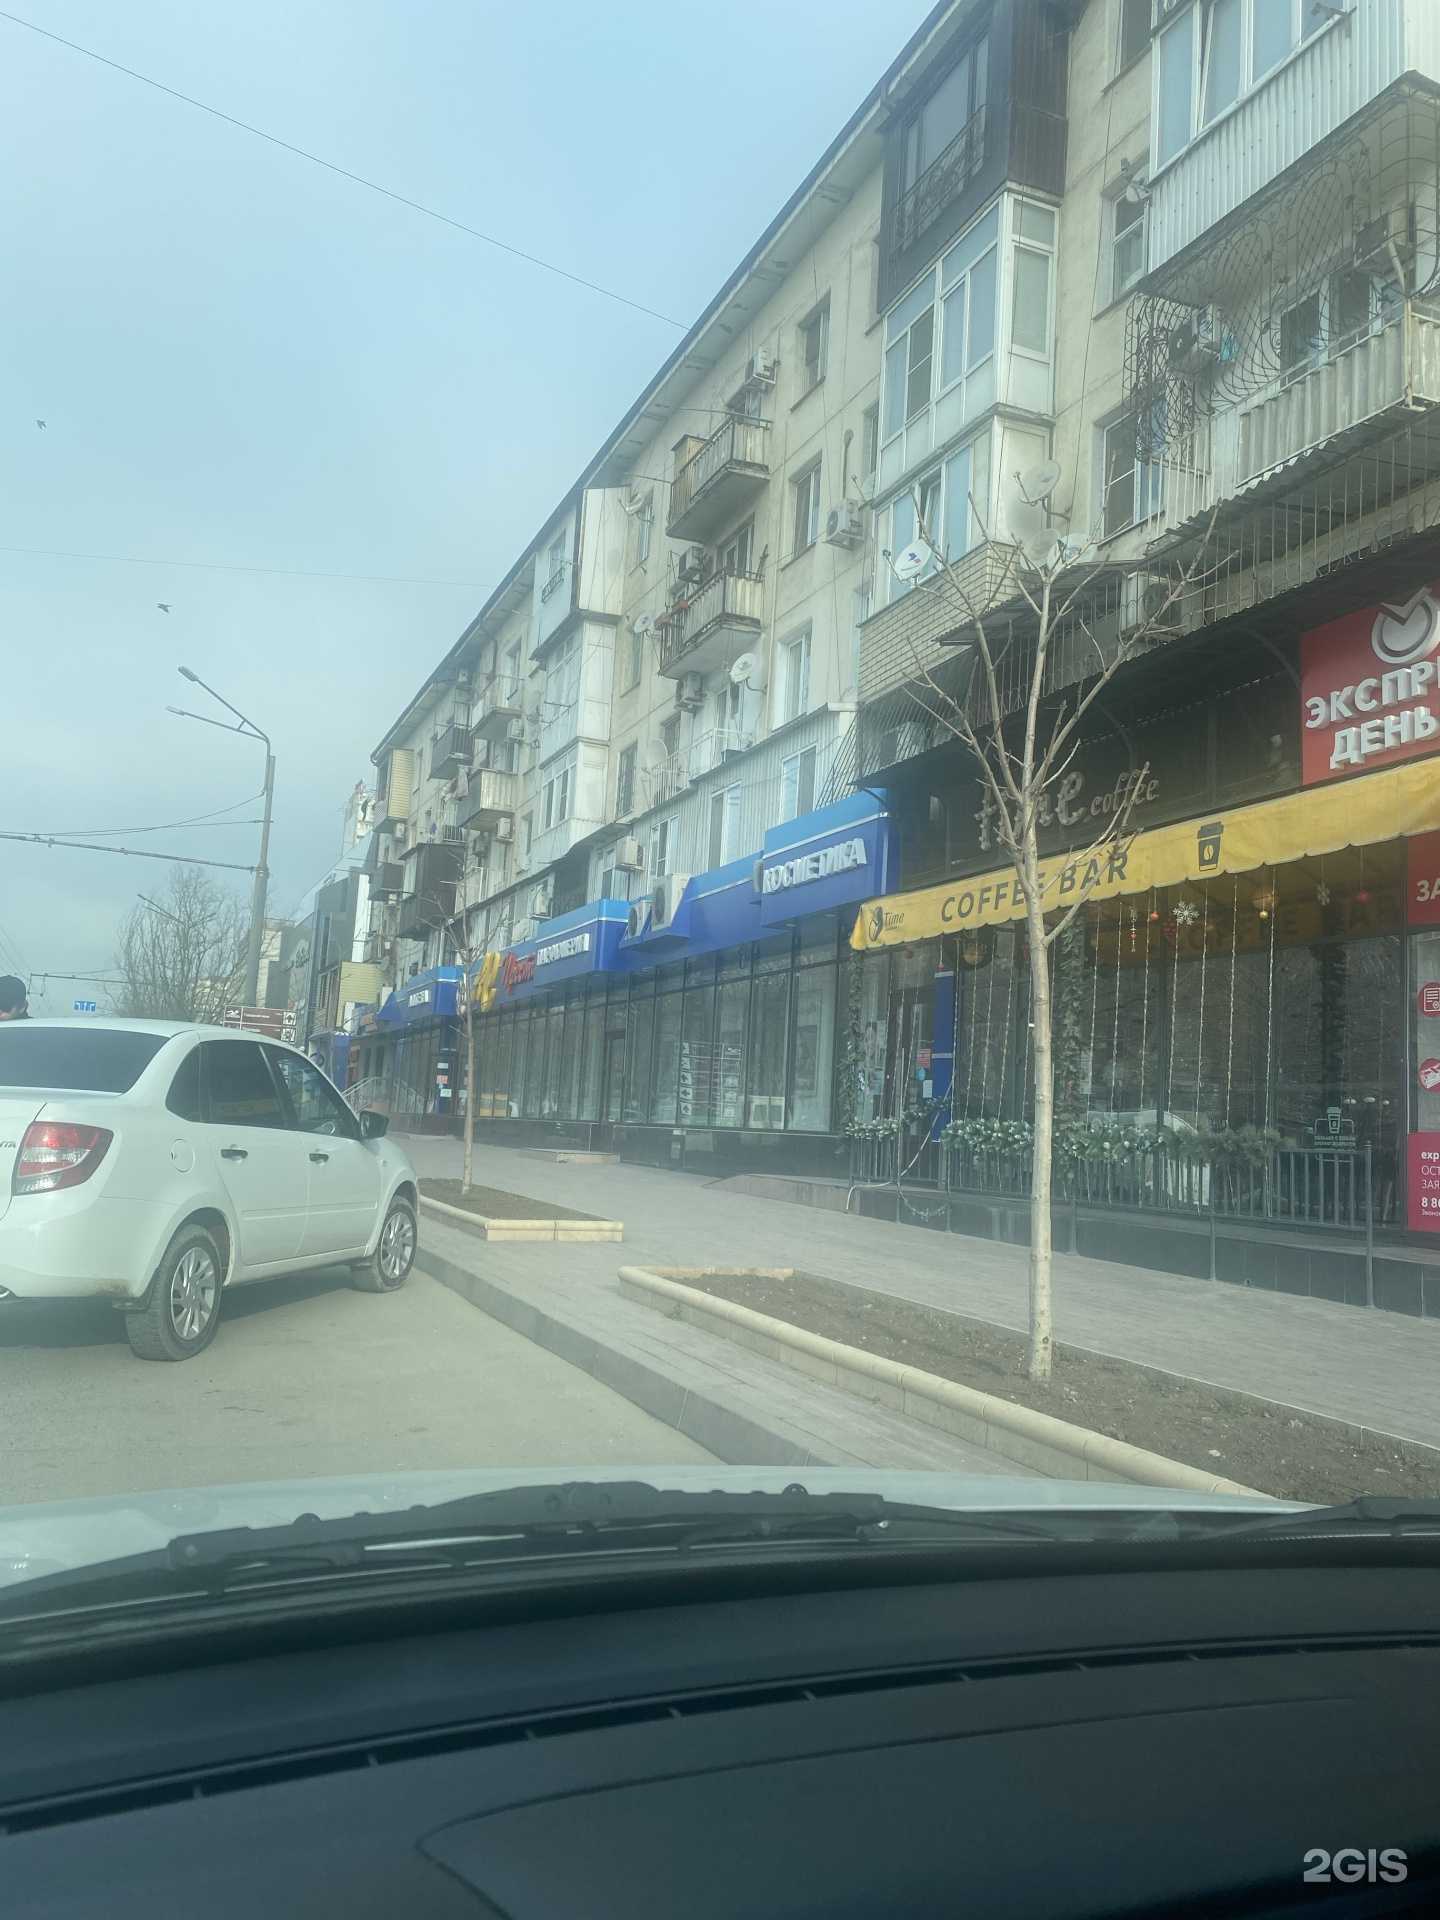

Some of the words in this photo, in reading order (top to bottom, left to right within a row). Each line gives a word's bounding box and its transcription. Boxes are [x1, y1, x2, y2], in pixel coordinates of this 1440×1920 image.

[1305, 655, 1440, 729] ЭКСПР
[1330, 706, 1440, 770] ДЕНЬ
[762, 837, 867, 894] КОСМЕТИКА
[1059, 850, 1127, 894] BAR
[1421, 1197, 1428, 1208] 8
